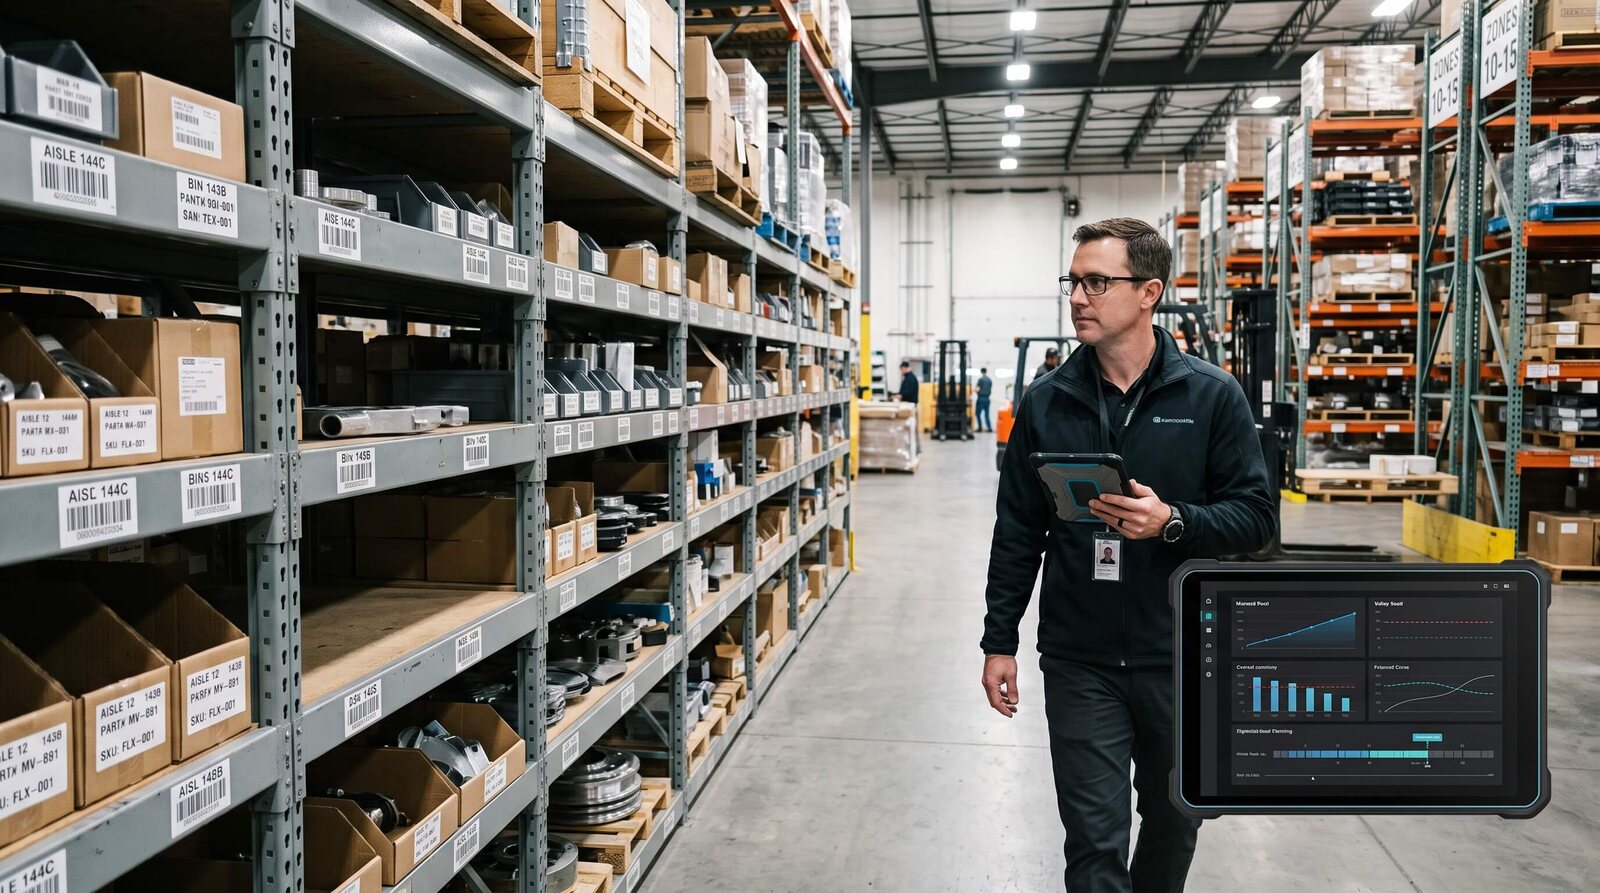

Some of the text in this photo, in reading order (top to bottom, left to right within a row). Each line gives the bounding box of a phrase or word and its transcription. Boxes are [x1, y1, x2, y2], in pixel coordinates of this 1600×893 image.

[1486, 6, 1518, 44] ZONES
[1434, 48, 1459, 81] ZONES
[1484, 38, 1517, 84] 10-15
[1432, 77, 1458, 116] 10-15
[44, 144, 105, 170] AISLE 144C
[188, 177, 226, 196] BIN 143B
[22, 414, 40, 423] AISLE
[42, 414, 50, 422] 12
[105, 410, 120, 418] AISLE
[122, 410, 129, 418] 12
[188, 468, 234, 485] BINS 144C
[101, 482, 128, 498] 144C
[190, 672, 210, 688] AISLE
[212, 668, 220, 680] 12
[100, 702, 124, 720] AISLE
[126, 697, 135, 709] 12
[122, 730, 154, 752] FLX-001
[0, 748, 13, 764] LE
[18, 742, 28, 756] 12
[0, 776, 54, 810] U: FLX-001
[179, 780, 199, 798] AISL
[22, 860, 54, 886] 144C
